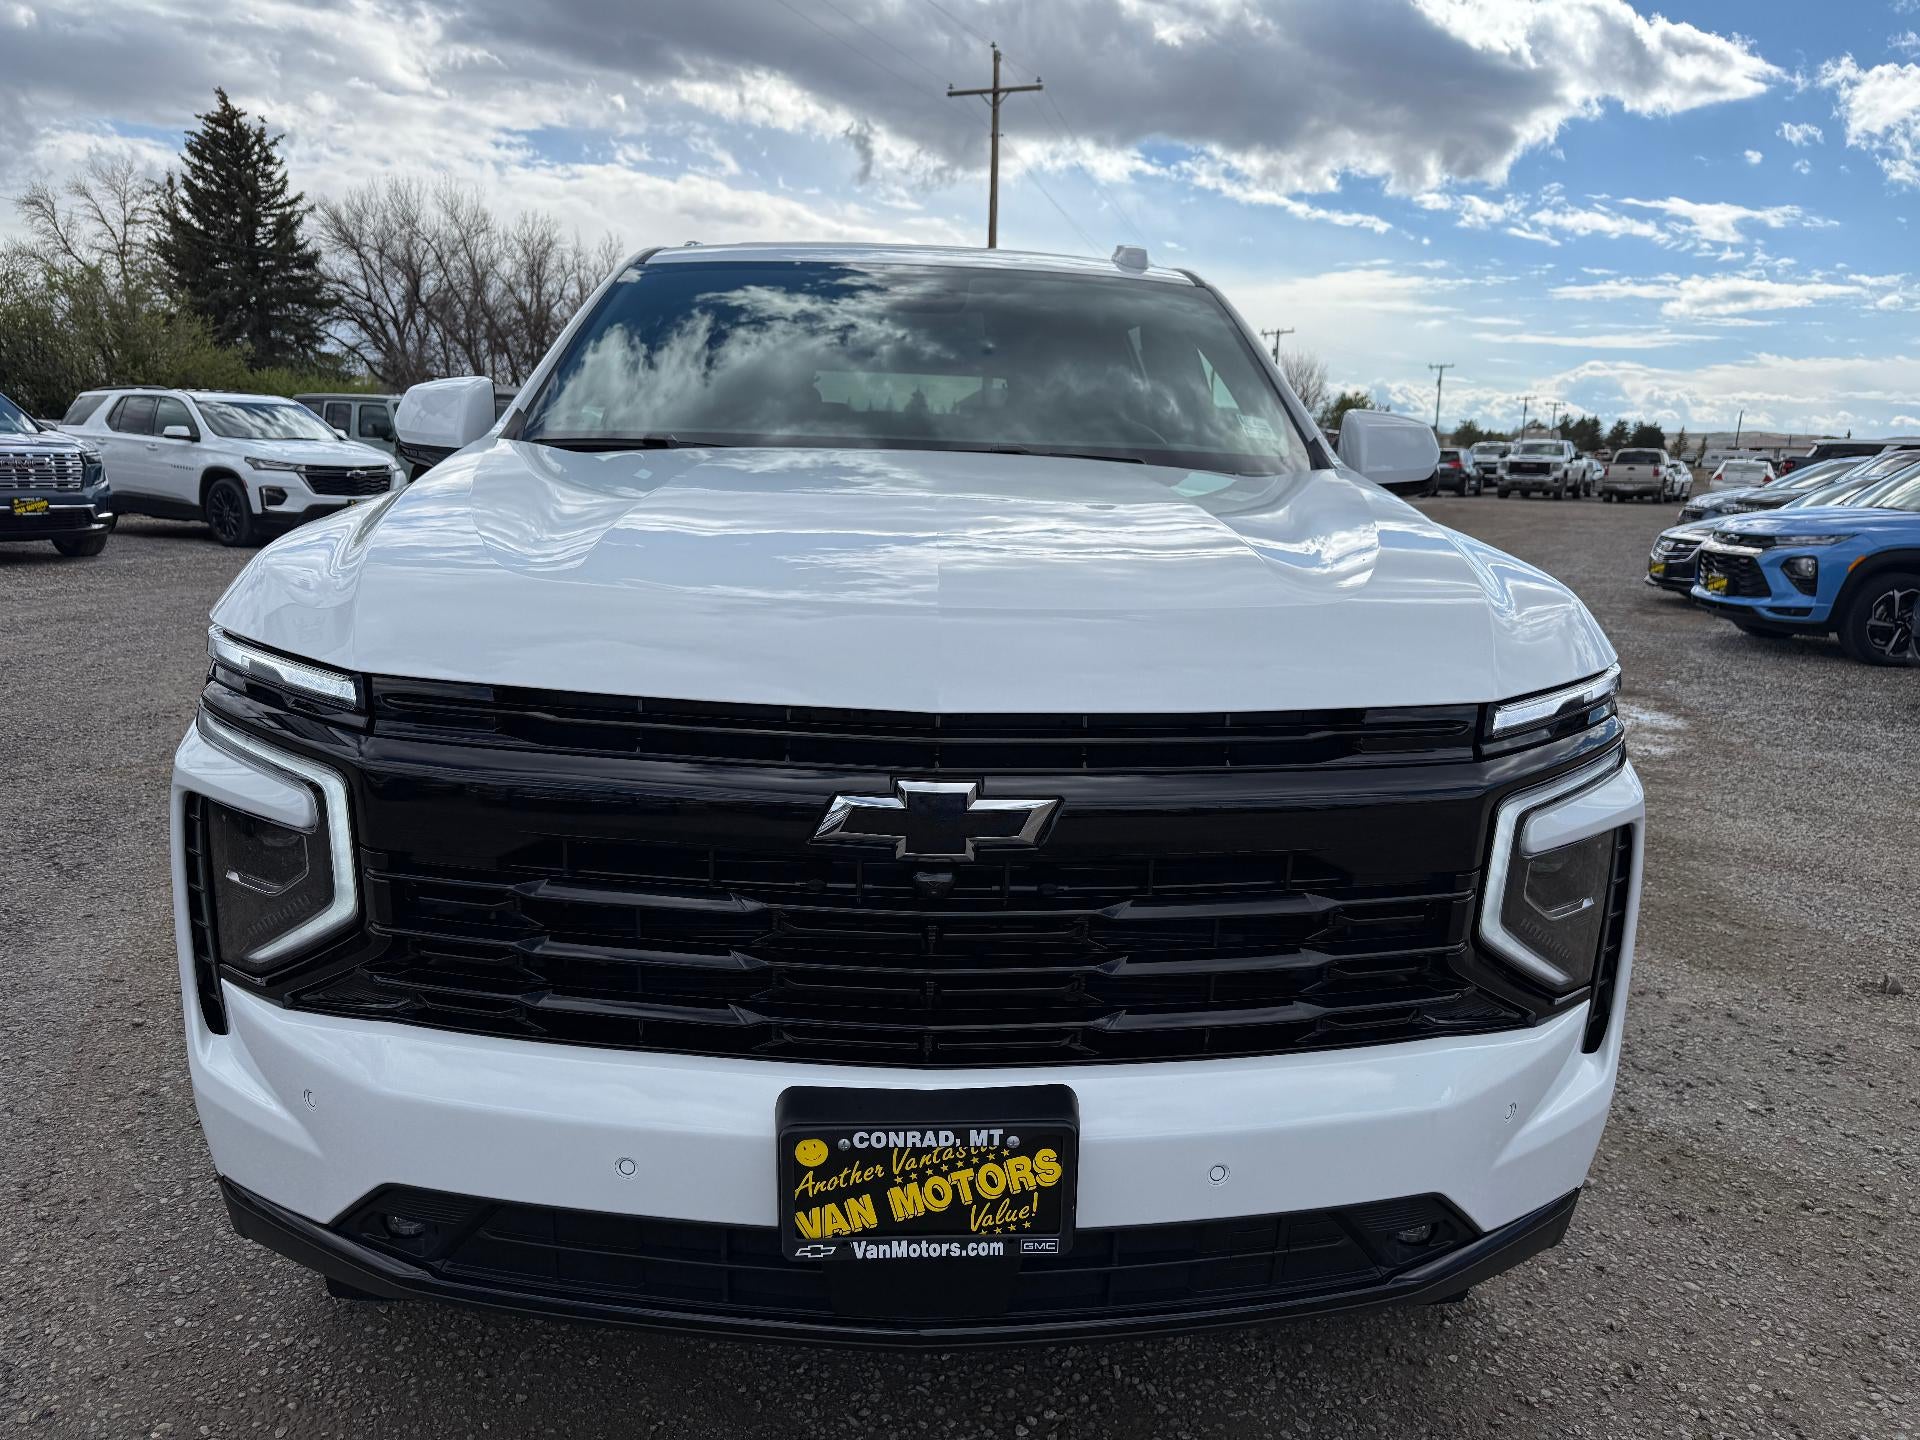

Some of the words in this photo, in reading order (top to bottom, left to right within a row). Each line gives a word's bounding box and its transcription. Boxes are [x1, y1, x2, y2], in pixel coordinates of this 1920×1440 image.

[853, 1131, 961, 1148] CONRAD,
[969, 1129, 1004, 1147] MT
[795, 1160, 885, 1200] Another
[795, 1194, 878, 1240] VAN
[887, 1148, 1063, 1222] MOTORS
[970, 1192, 1039, 1232] Value!
[853, 1240, 1004, 1260] VanMotors.com
[1023, 1242, 1056, 1250] GMC
